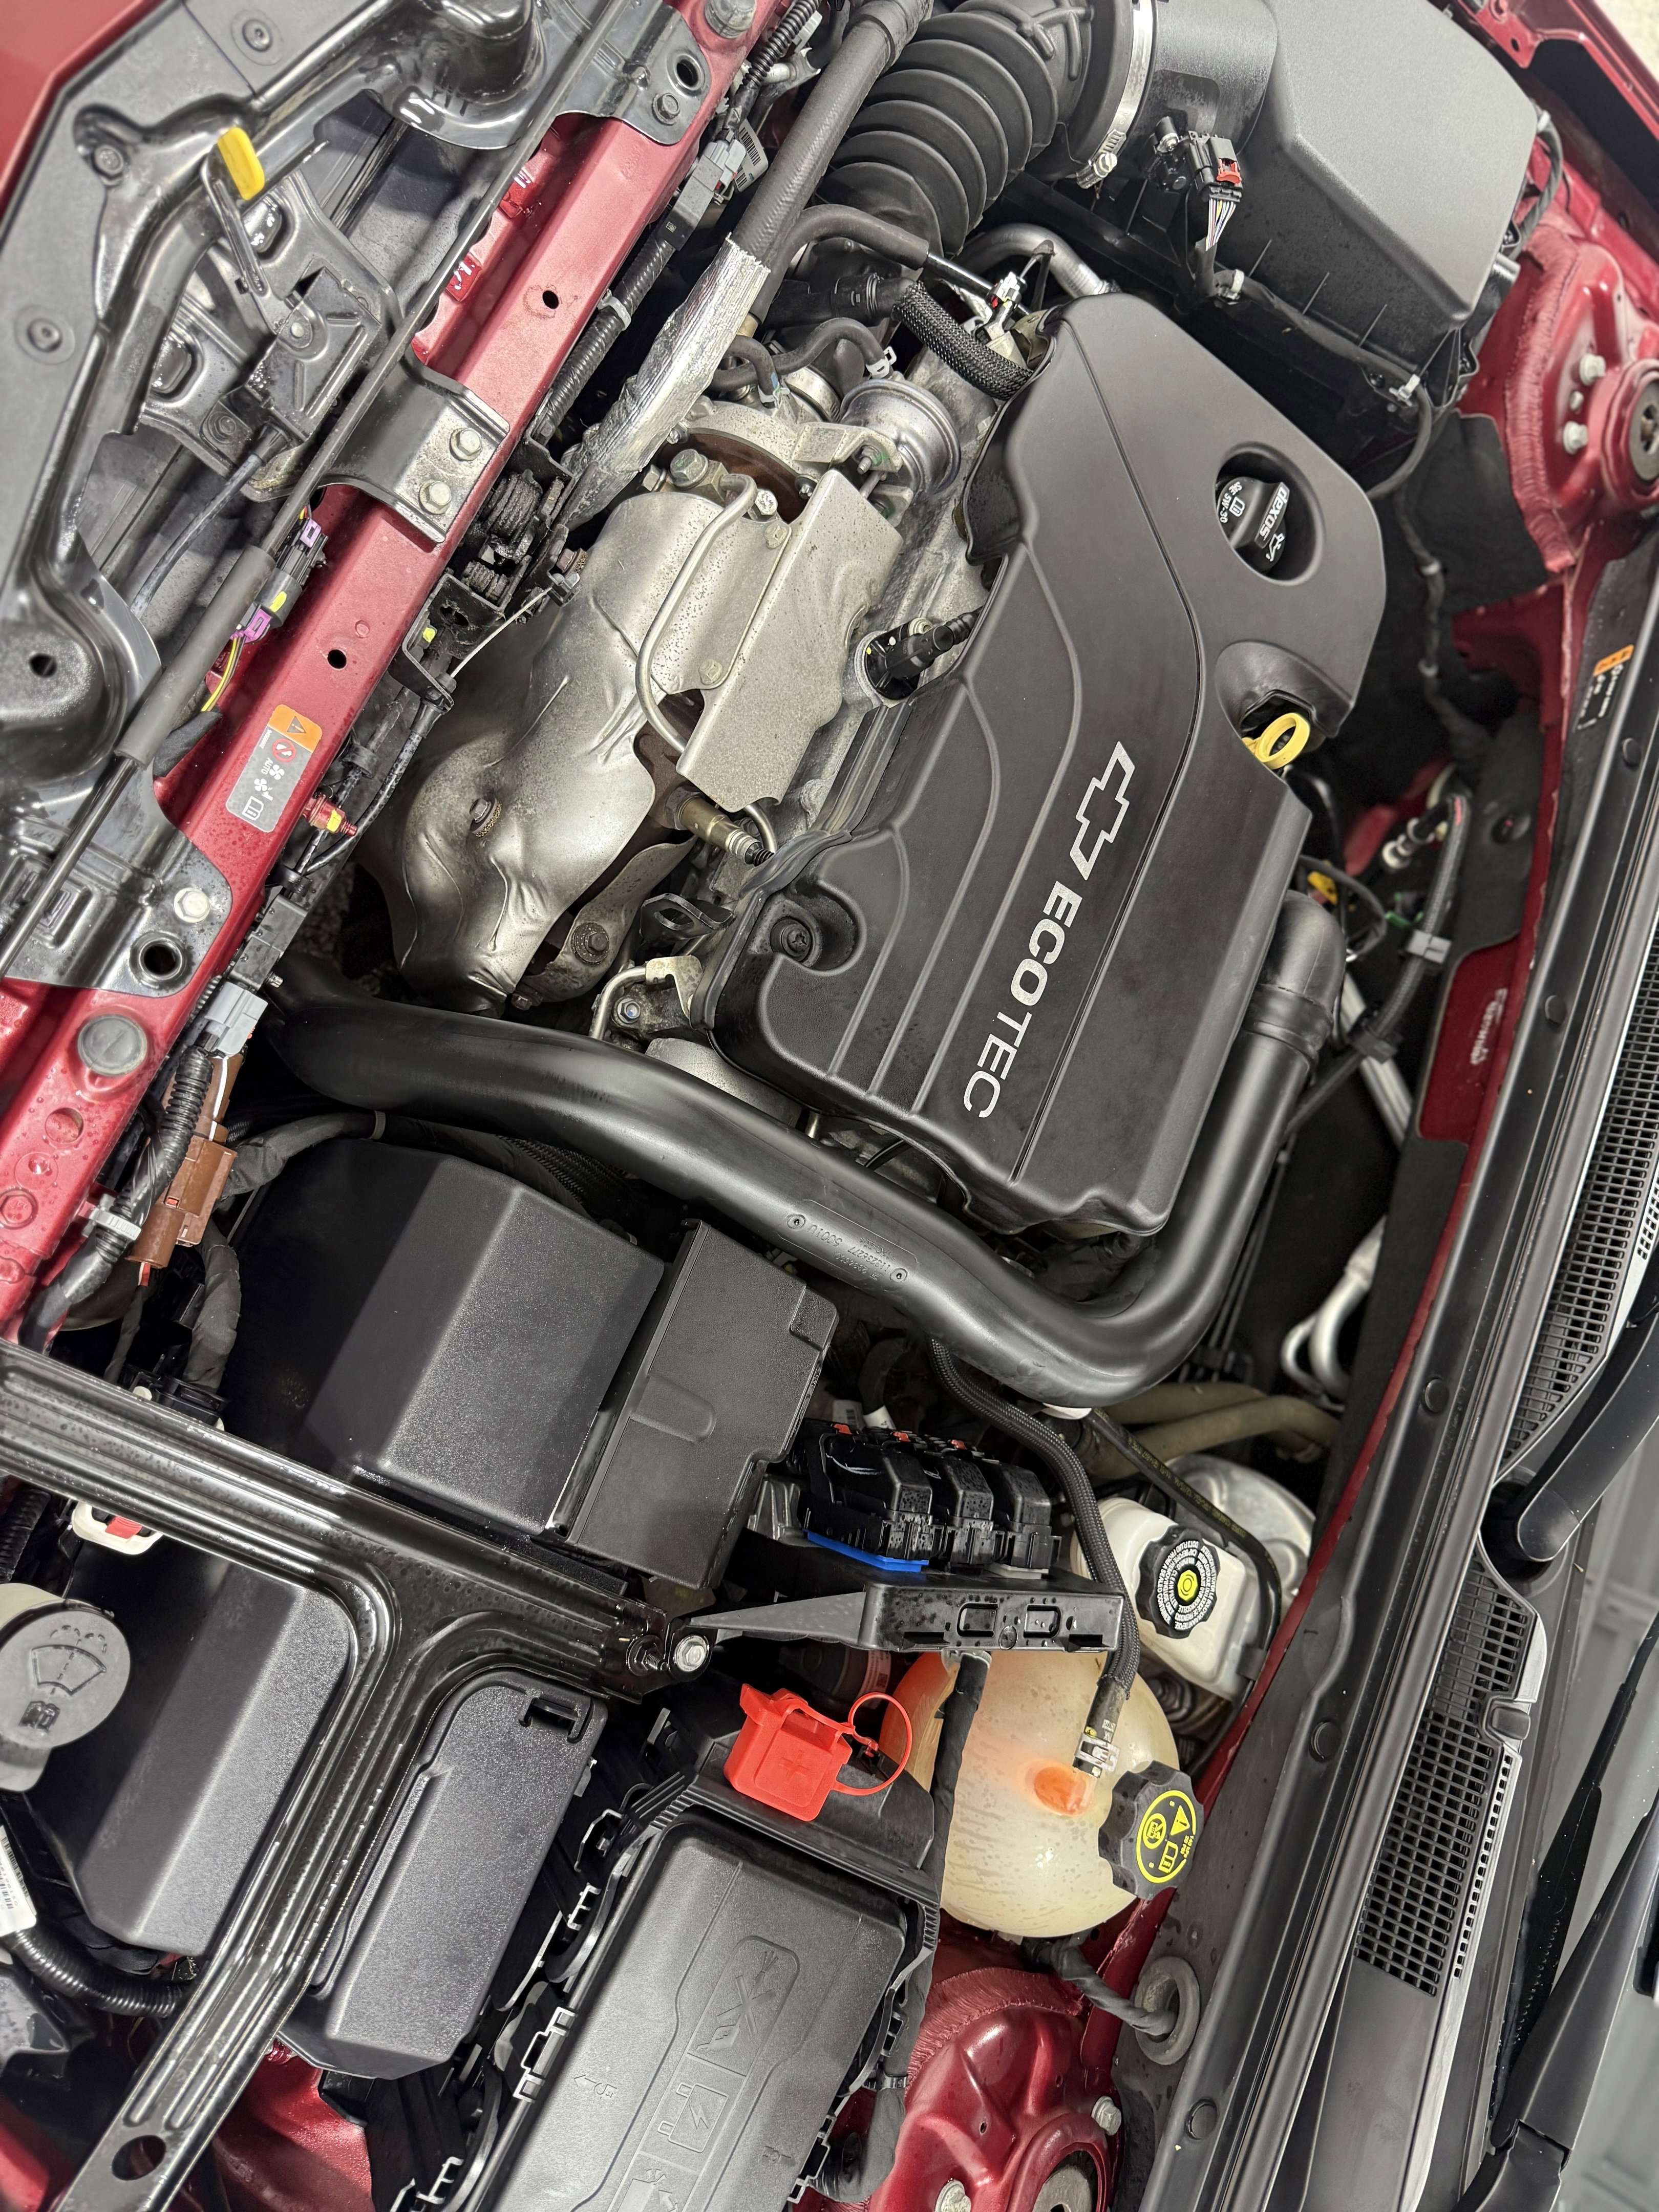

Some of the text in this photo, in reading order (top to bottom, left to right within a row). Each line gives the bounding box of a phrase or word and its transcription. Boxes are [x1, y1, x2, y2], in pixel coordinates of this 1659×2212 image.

[1220, 481, 1242, 523] SAE 5W-30
[1260, 486, 1287, 540] dexos
[262, 758, 273, 775] AUTO
[964, 881, 1082, 1118] ECOTEC
[1176, 1541, 1187, 1552] FLUID
[1164, 1549, 1177, 1566] FROM
[1173, 1549, 1188, 1564] BEFORE
[1157, 1569, 1166, 1592] SEALED
[1168, 1570, 1178, 1589] CLEAN
[1165, 1602, 1175, 1615] ONLY
[1168, 1590, 1178, 1609] FILLER
[1157, 1593, 1172, 1626] CONTAINER
